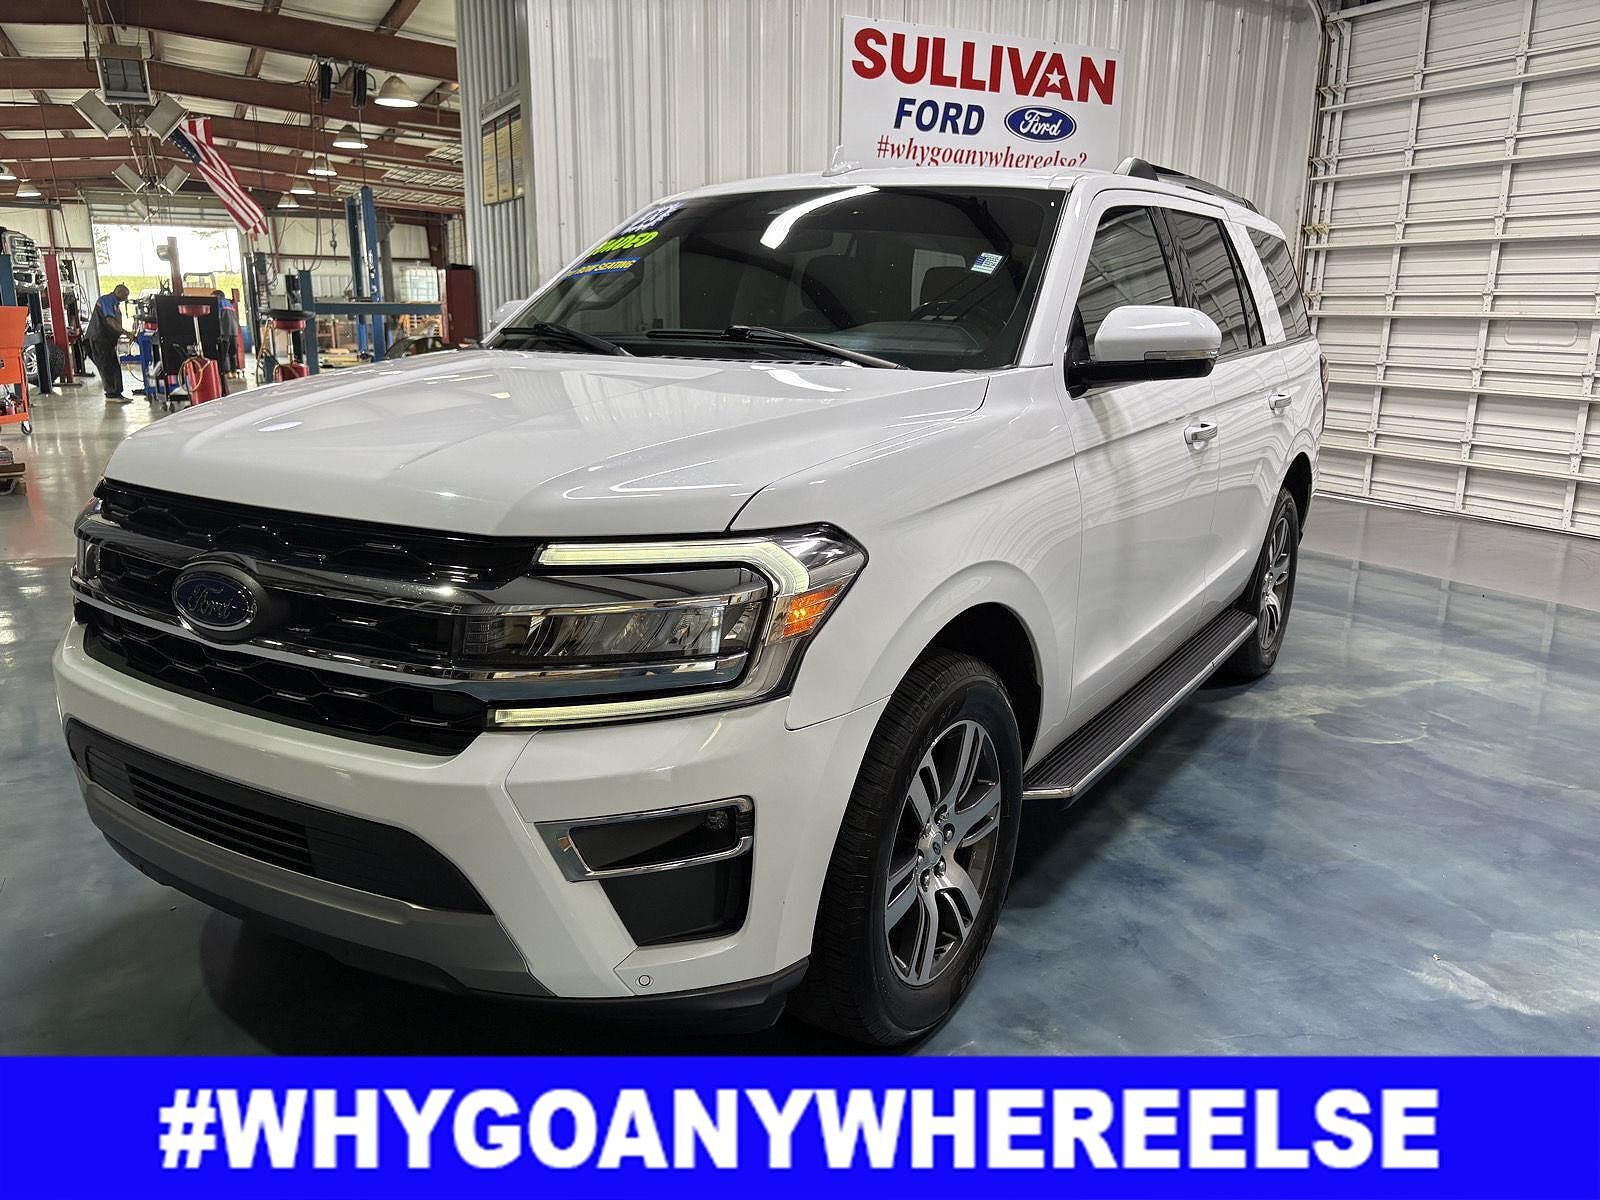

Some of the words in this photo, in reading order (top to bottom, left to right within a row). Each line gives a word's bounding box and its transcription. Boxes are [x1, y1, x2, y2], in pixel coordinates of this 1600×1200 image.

[851, 27, 1117, 105] SULLIVAN
[893, 97, 986, 137] FORD
[1019, 109, 1062, 138] Ford
[187, 583, 234, 619] Ford
